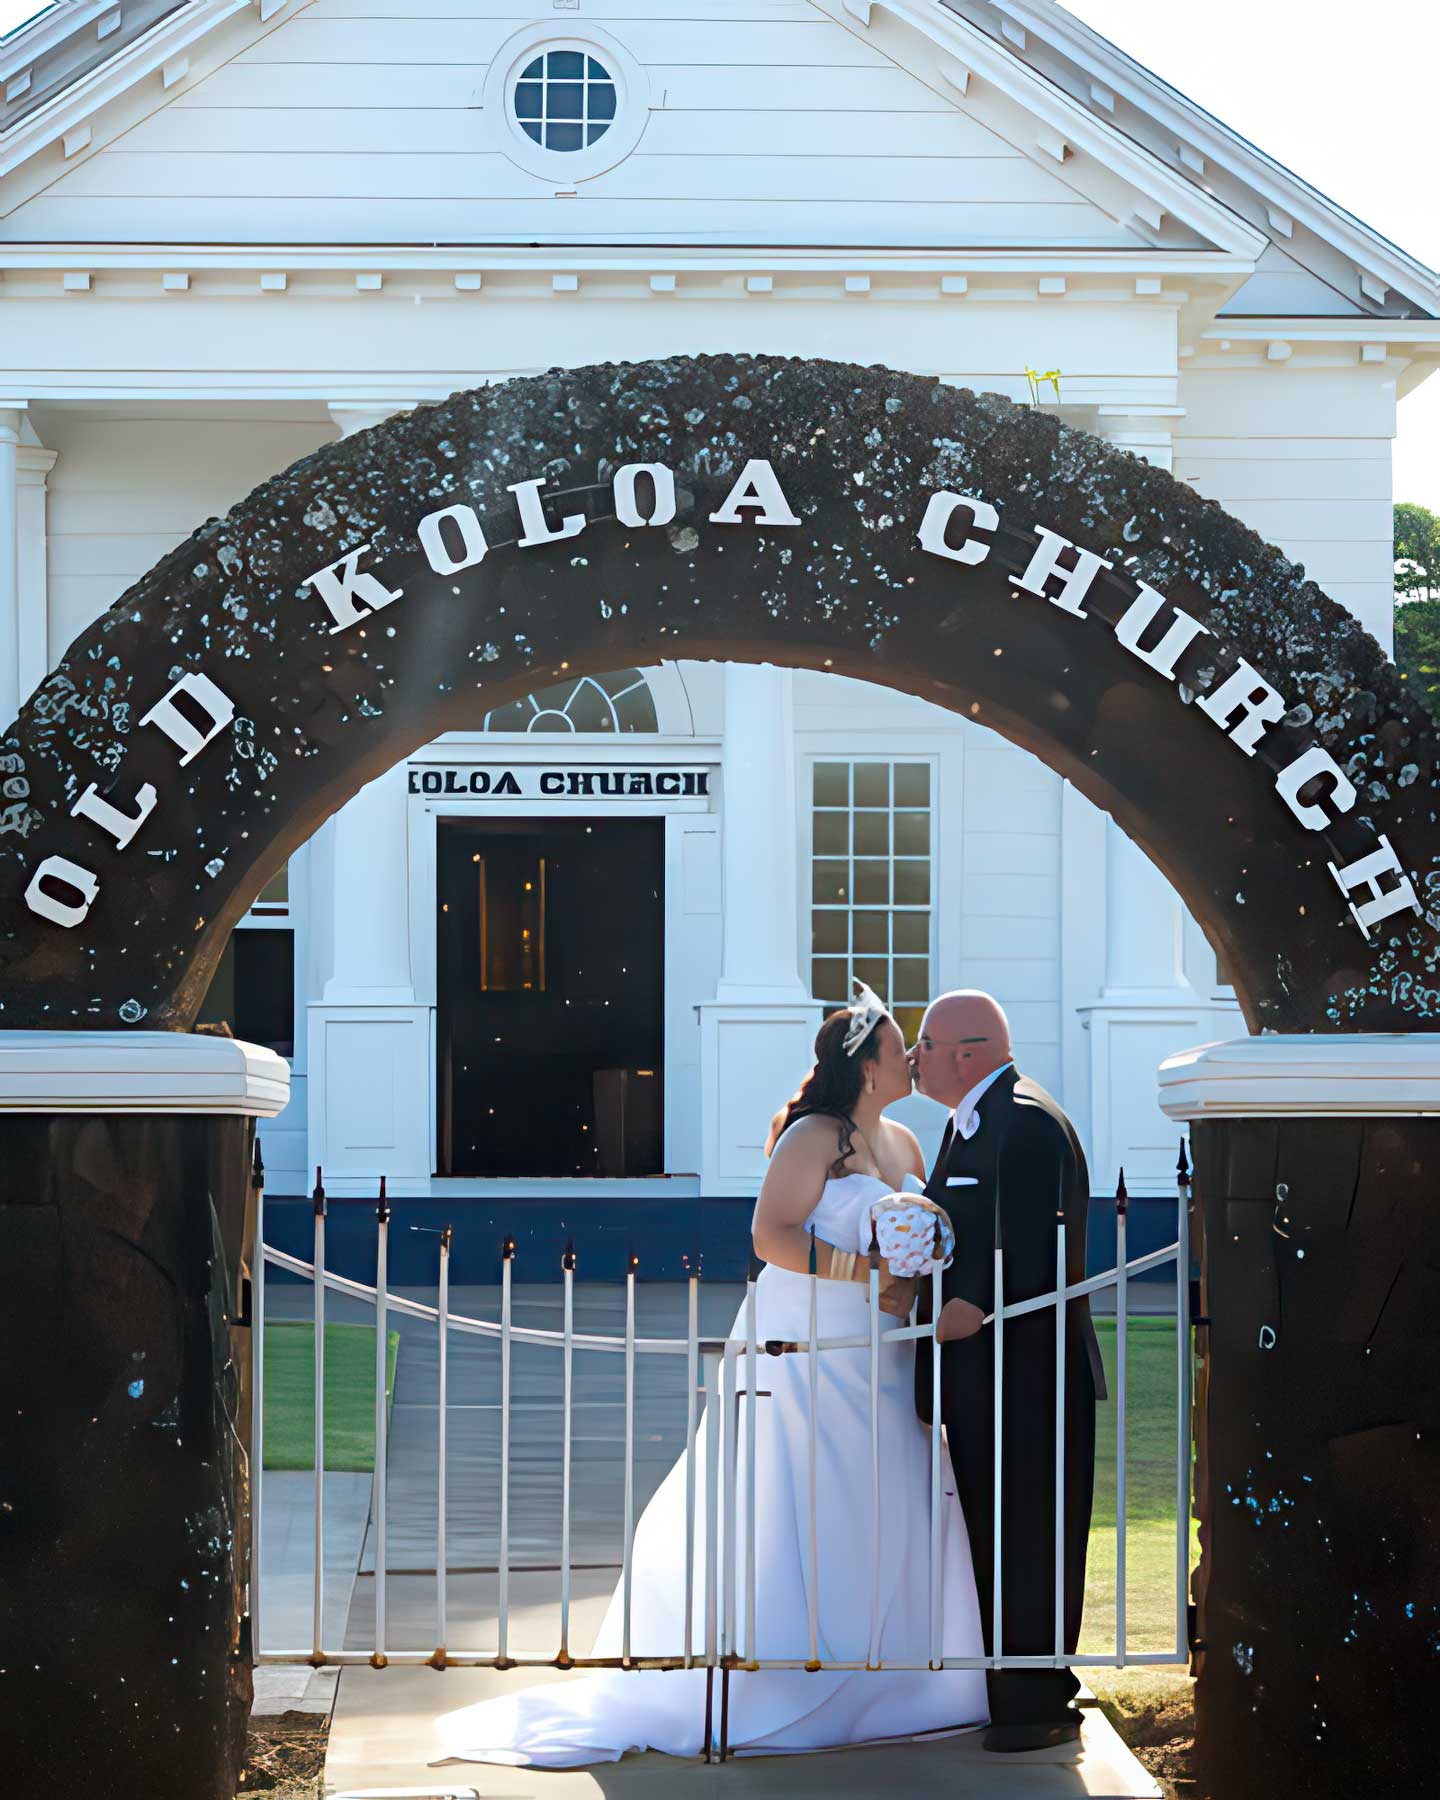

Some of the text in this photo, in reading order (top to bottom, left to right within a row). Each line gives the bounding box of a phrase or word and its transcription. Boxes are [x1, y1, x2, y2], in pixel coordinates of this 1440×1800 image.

[24, 458, 1424, 941] OLD KOLOA CHURCH
